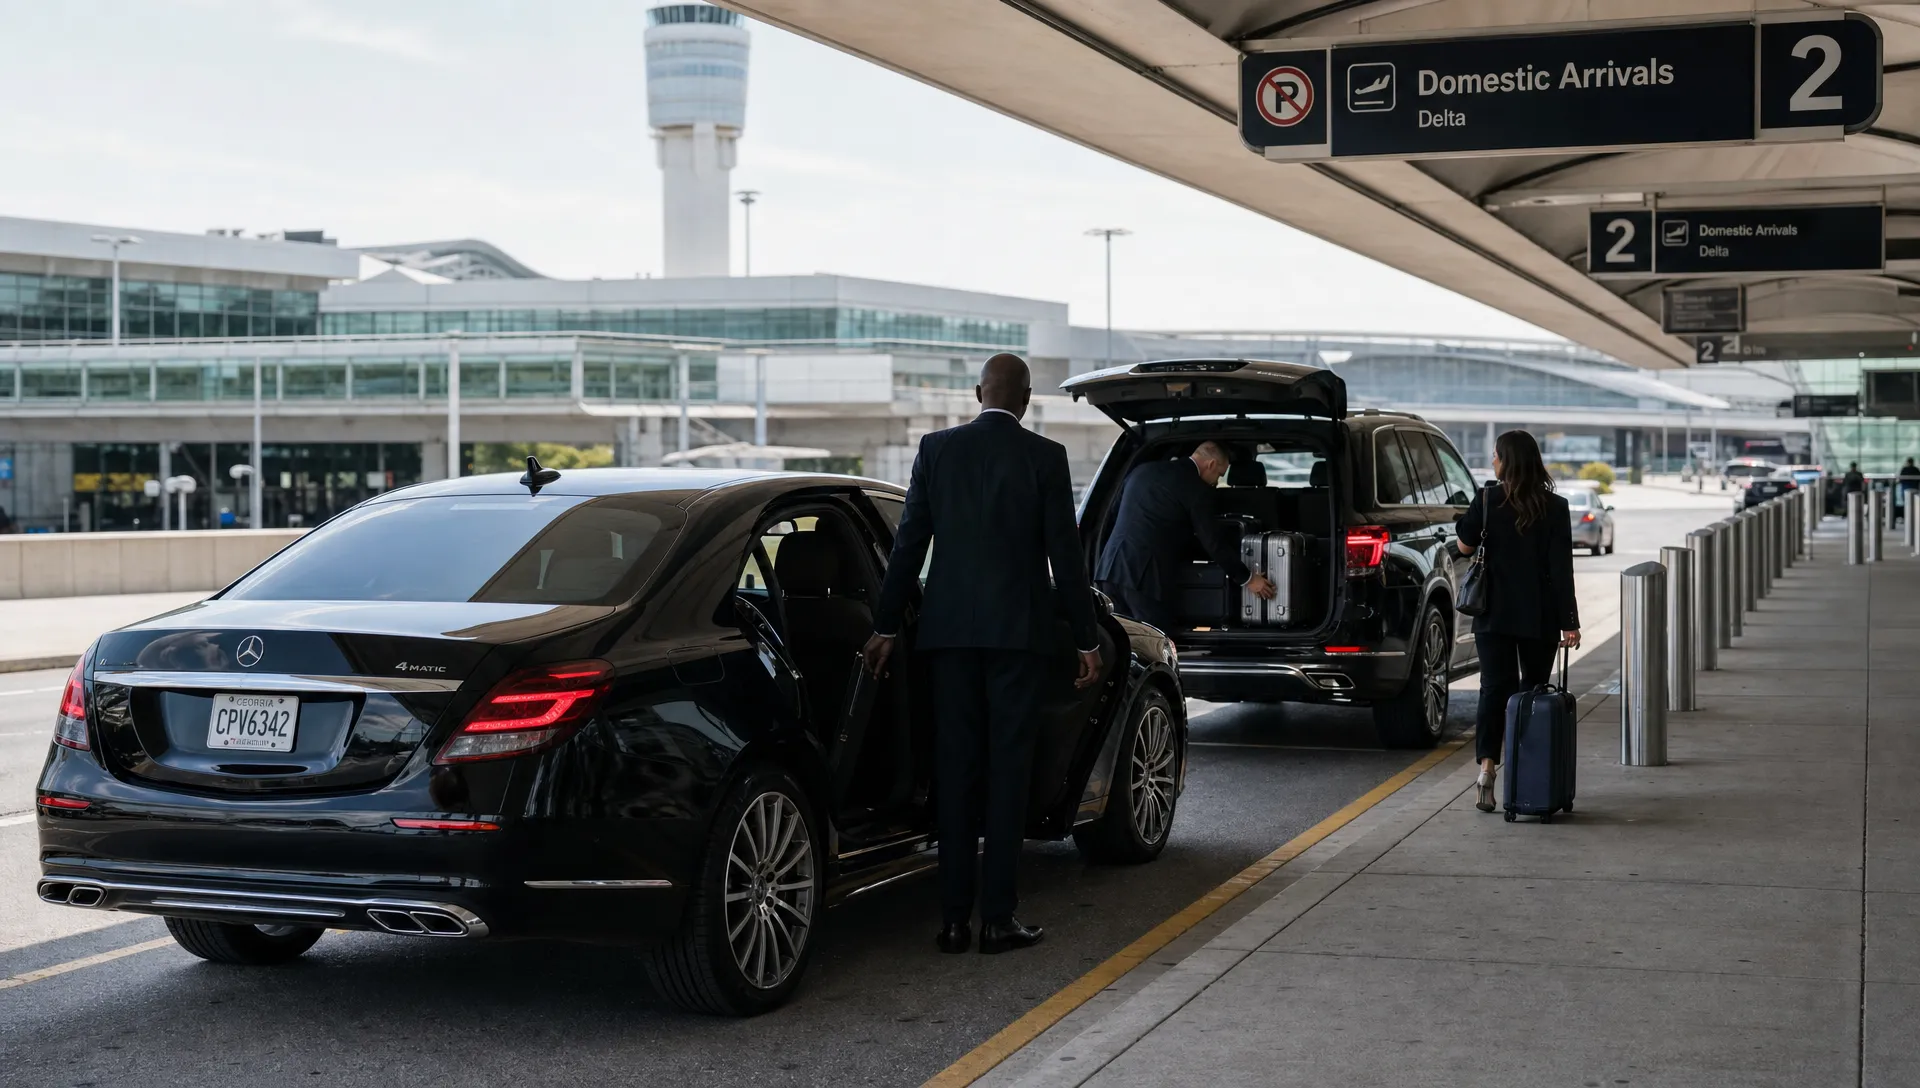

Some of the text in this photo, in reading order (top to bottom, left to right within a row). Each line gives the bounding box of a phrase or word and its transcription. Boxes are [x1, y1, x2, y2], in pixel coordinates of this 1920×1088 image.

[1417, 57, 1675, 96] Domestic Arrivals
[1789, 34, 1844, 112] 2
[1417, 108, 1467, 128] Delta
[1605, 218, 1636, 263] 2
[1699, 223, 1798, 237] Domestic Arrivals
[1699, 245, 1730, 257] Delta
[1701, 341, 1715, 361] 2
[215, 708, 290, 737] CPV6342
